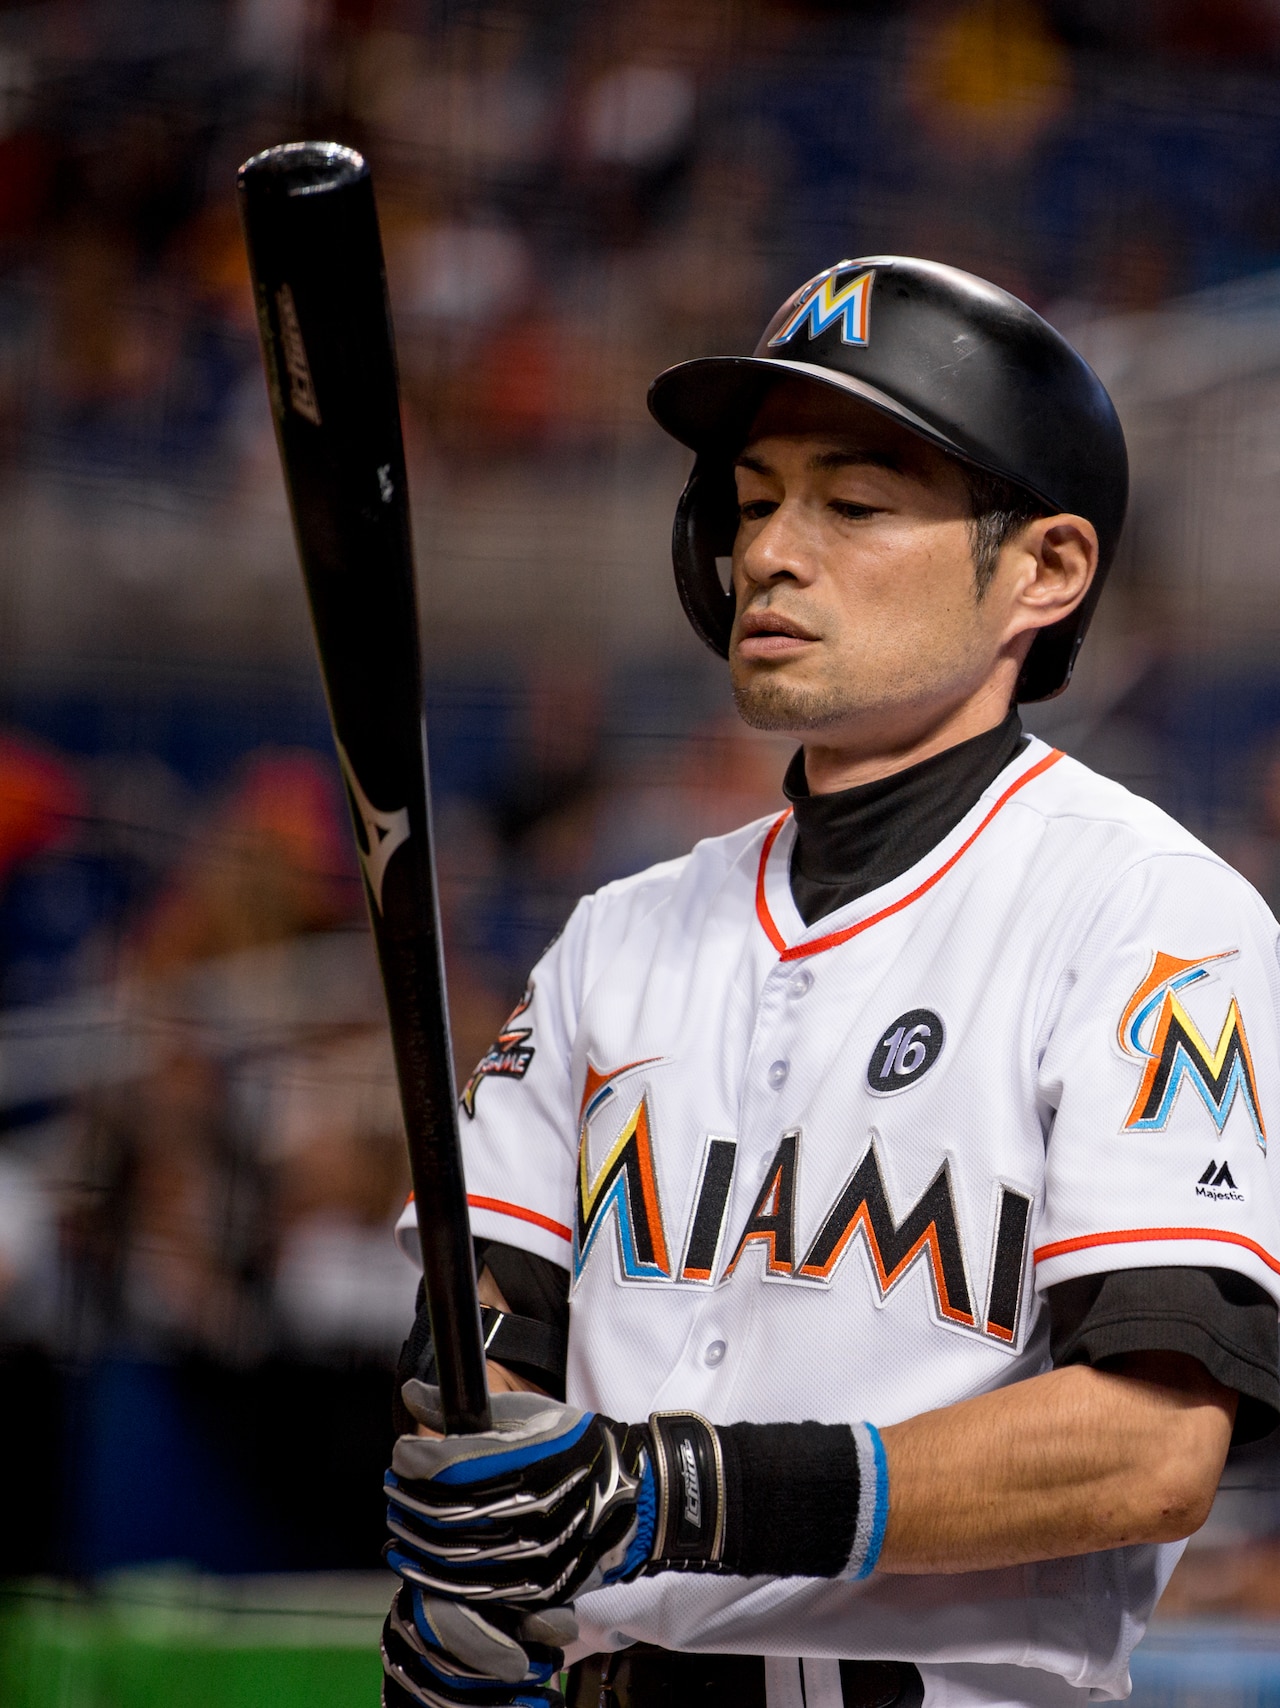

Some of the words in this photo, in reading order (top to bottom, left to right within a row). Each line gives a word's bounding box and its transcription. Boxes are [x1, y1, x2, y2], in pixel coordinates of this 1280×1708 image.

[767, 268, 877, 347] M
[880, 1024, 931, 1078] 16
[1118, 982, 1267, 1158] M
[570, 1080, 1034, 1355] MIAMI
[1195, 1186, 1245, 1202] Majestic
